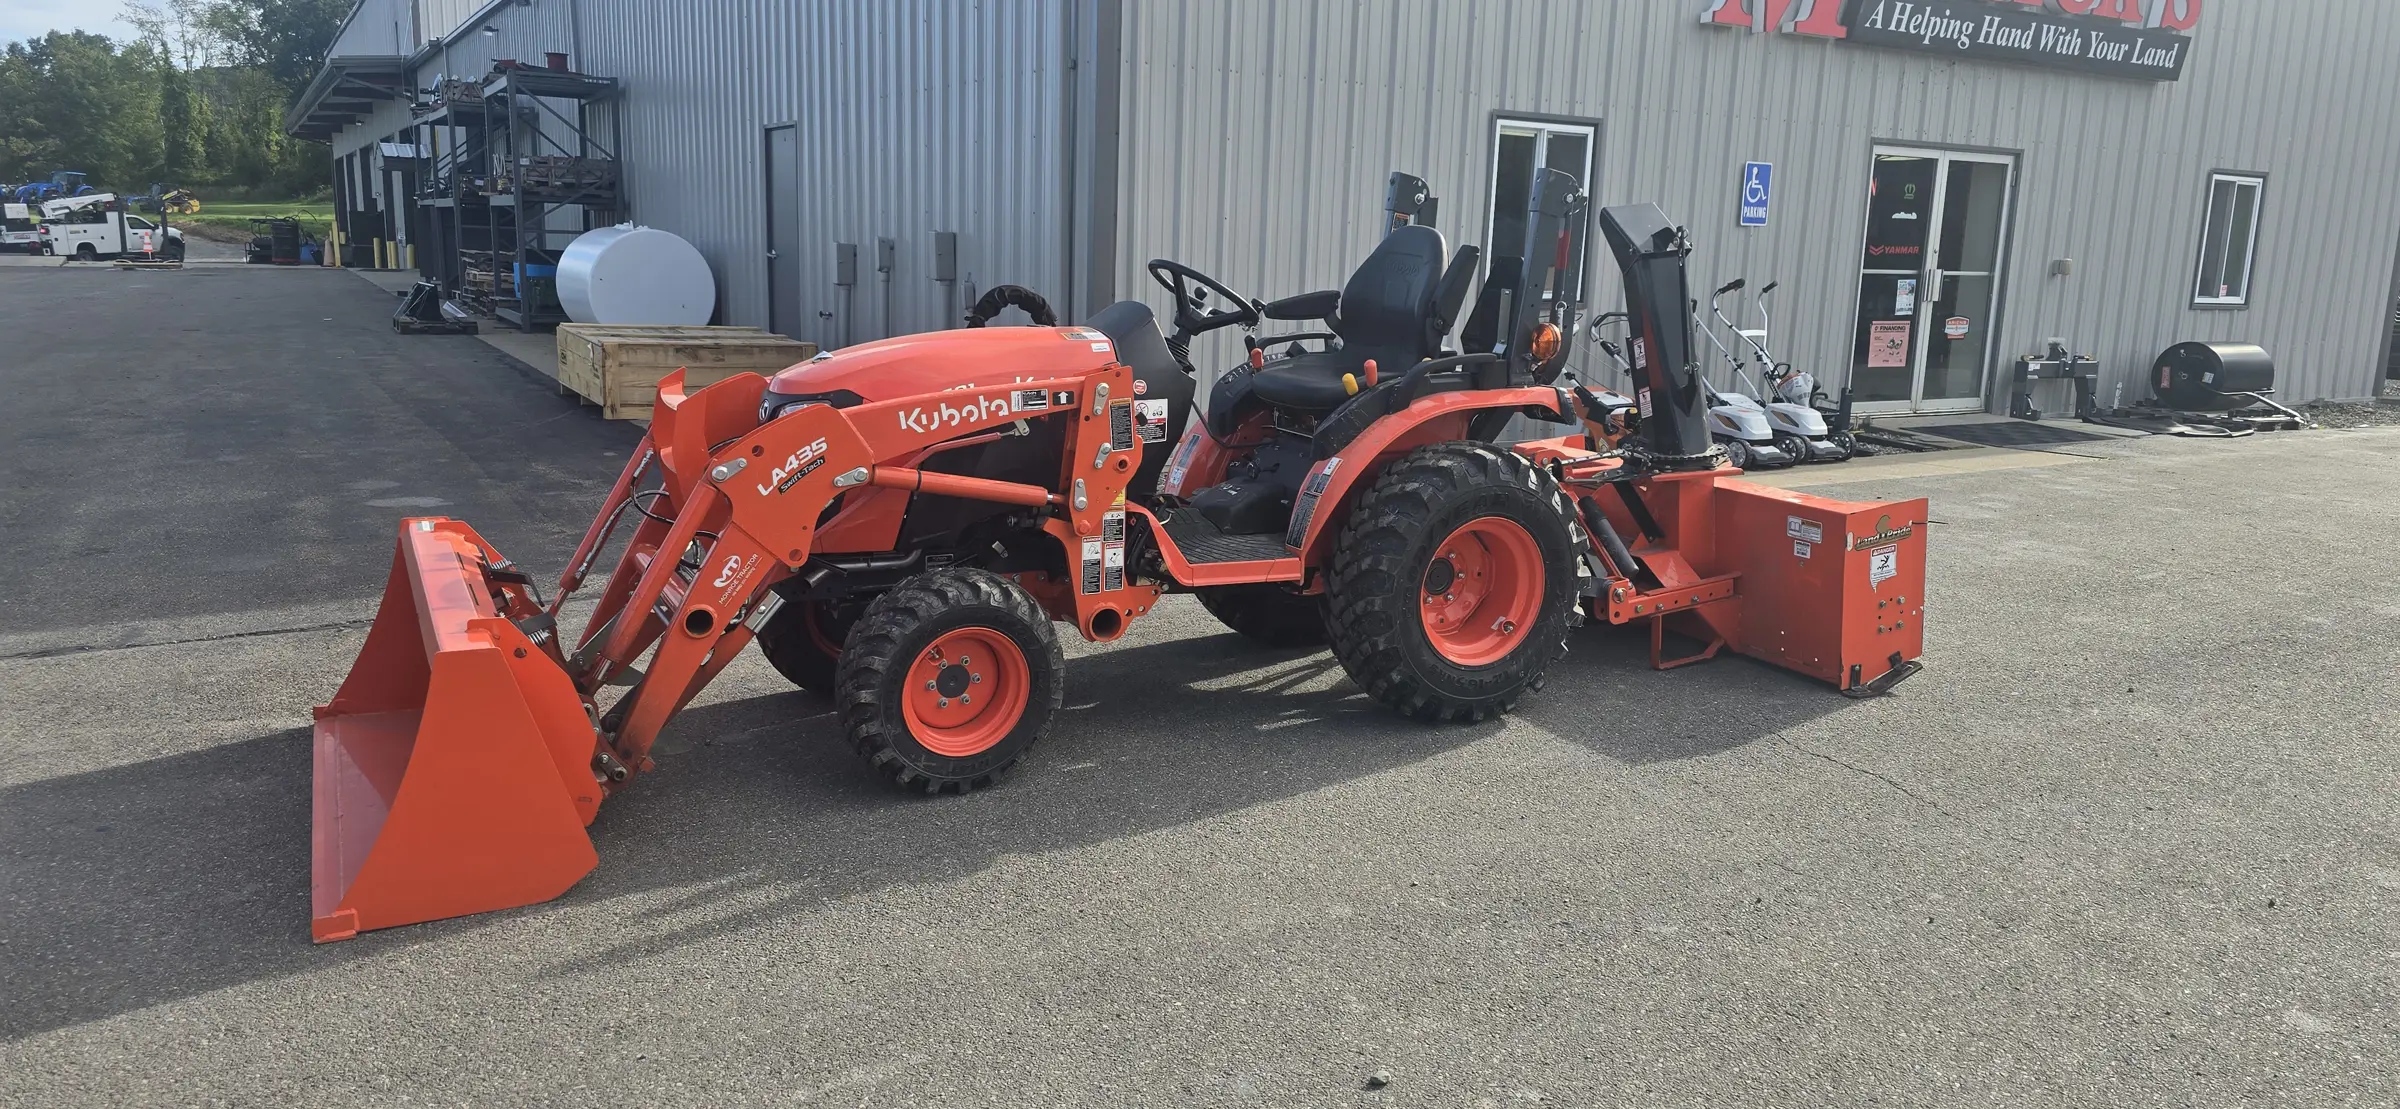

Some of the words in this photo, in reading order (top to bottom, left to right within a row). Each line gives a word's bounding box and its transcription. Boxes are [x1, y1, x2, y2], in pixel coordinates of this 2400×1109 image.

[1865, 0, 1883, 28] A
[1888, 1, 1975, 49] Helping
[1977, 15, 2036, 50] Hand
[2039, 23, 2083, 56] With
[2087, 30, 2129, 62] Your
[2131, 37, 2179, 69] Land
[1744, 206, 1767, 219] PARKING
[1884, 246, 1920, 254] YANMAR
[898, 395, 1009, 433] Kubota
[757, 436, 828, 496] LA435
[781, 458, 824, 492] Swift-Tach
[1857, 532, 1880, 545] Land
[718, 579, 740, 605] MONROE
[736, 553, 759, 579] TRACTOR
